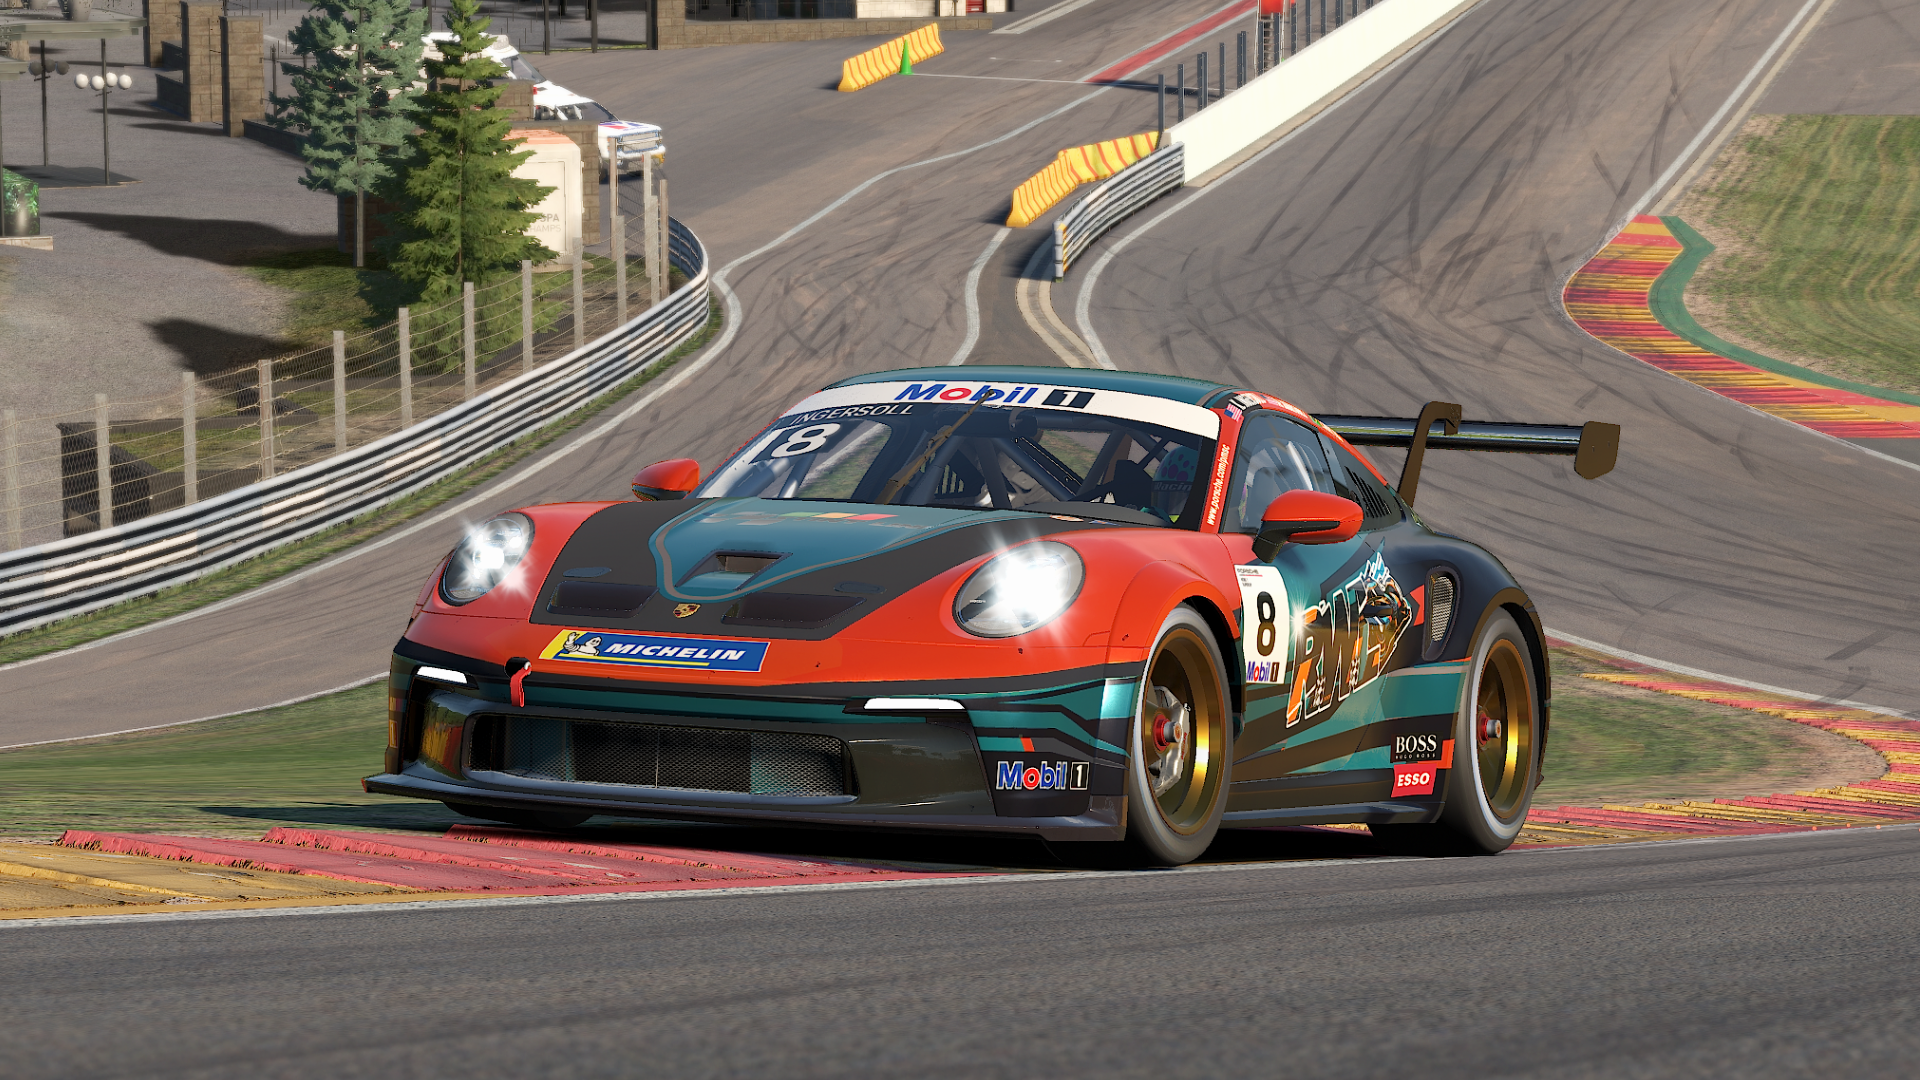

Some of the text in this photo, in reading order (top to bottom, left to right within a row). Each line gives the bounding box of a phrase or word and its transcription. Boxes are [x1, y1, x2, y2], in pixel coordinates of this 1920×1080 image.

[894, 384, 1039, 404] Mobil
[789, 404, 914, 426] INGERSOLL
[1153, 481, 1194, 491] Racin
[1256, 591, 1276, 657] 8
[604, 643, 746, 661] MICHELIN
[1246, 661, 1271, 682] Mobil
[1395, 734, 1437, 754] BOSS
[996, 761, 1068, 790] Mobil
[1397, 772, 1431, 787] ESSO
